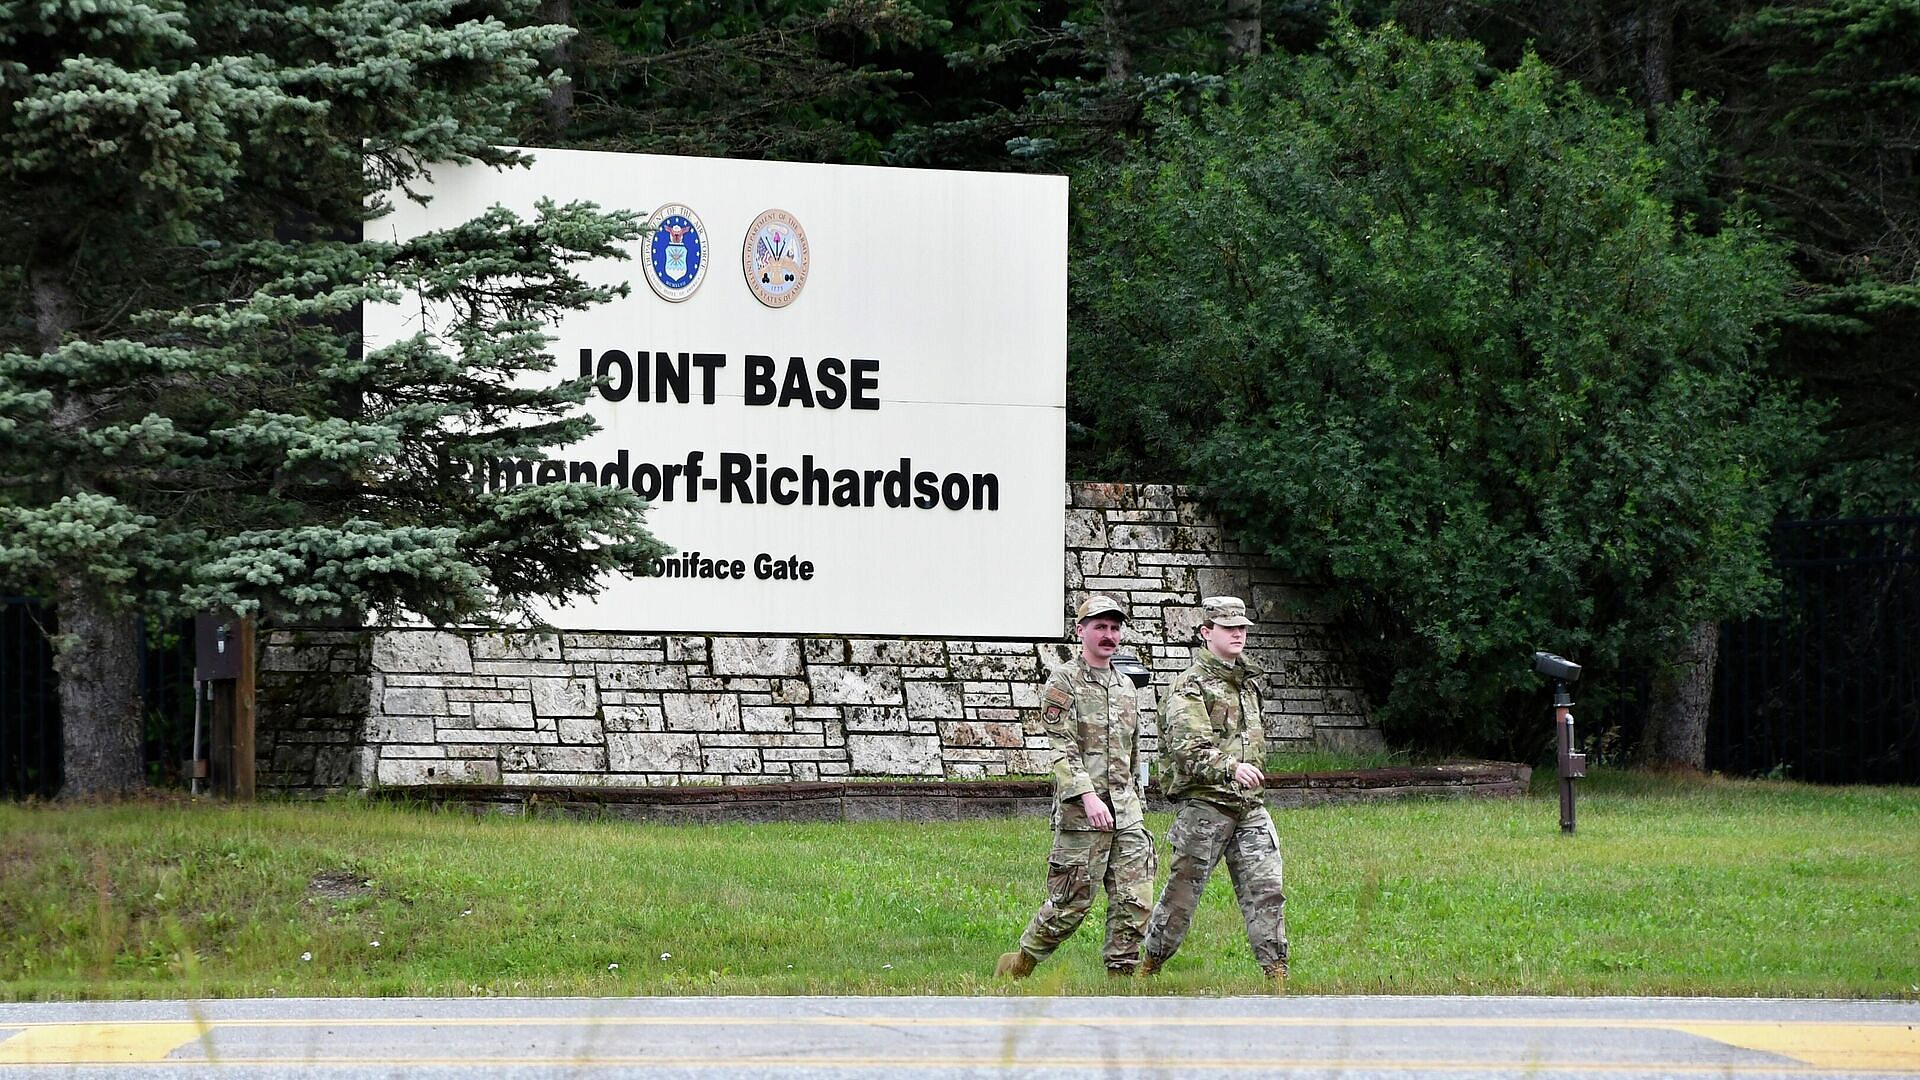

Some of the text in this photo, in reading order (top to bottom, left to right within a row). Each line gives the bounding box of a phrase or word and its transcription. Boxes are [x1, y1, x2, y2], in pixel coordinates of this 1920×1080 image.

[746, 213, 776, 253] DEPARTMENT
[744, 355, 880, 411] BASE
[440, 449, 999, 512] mendorf-Richardson
[632, 551, 815, 581] oniface Gate
